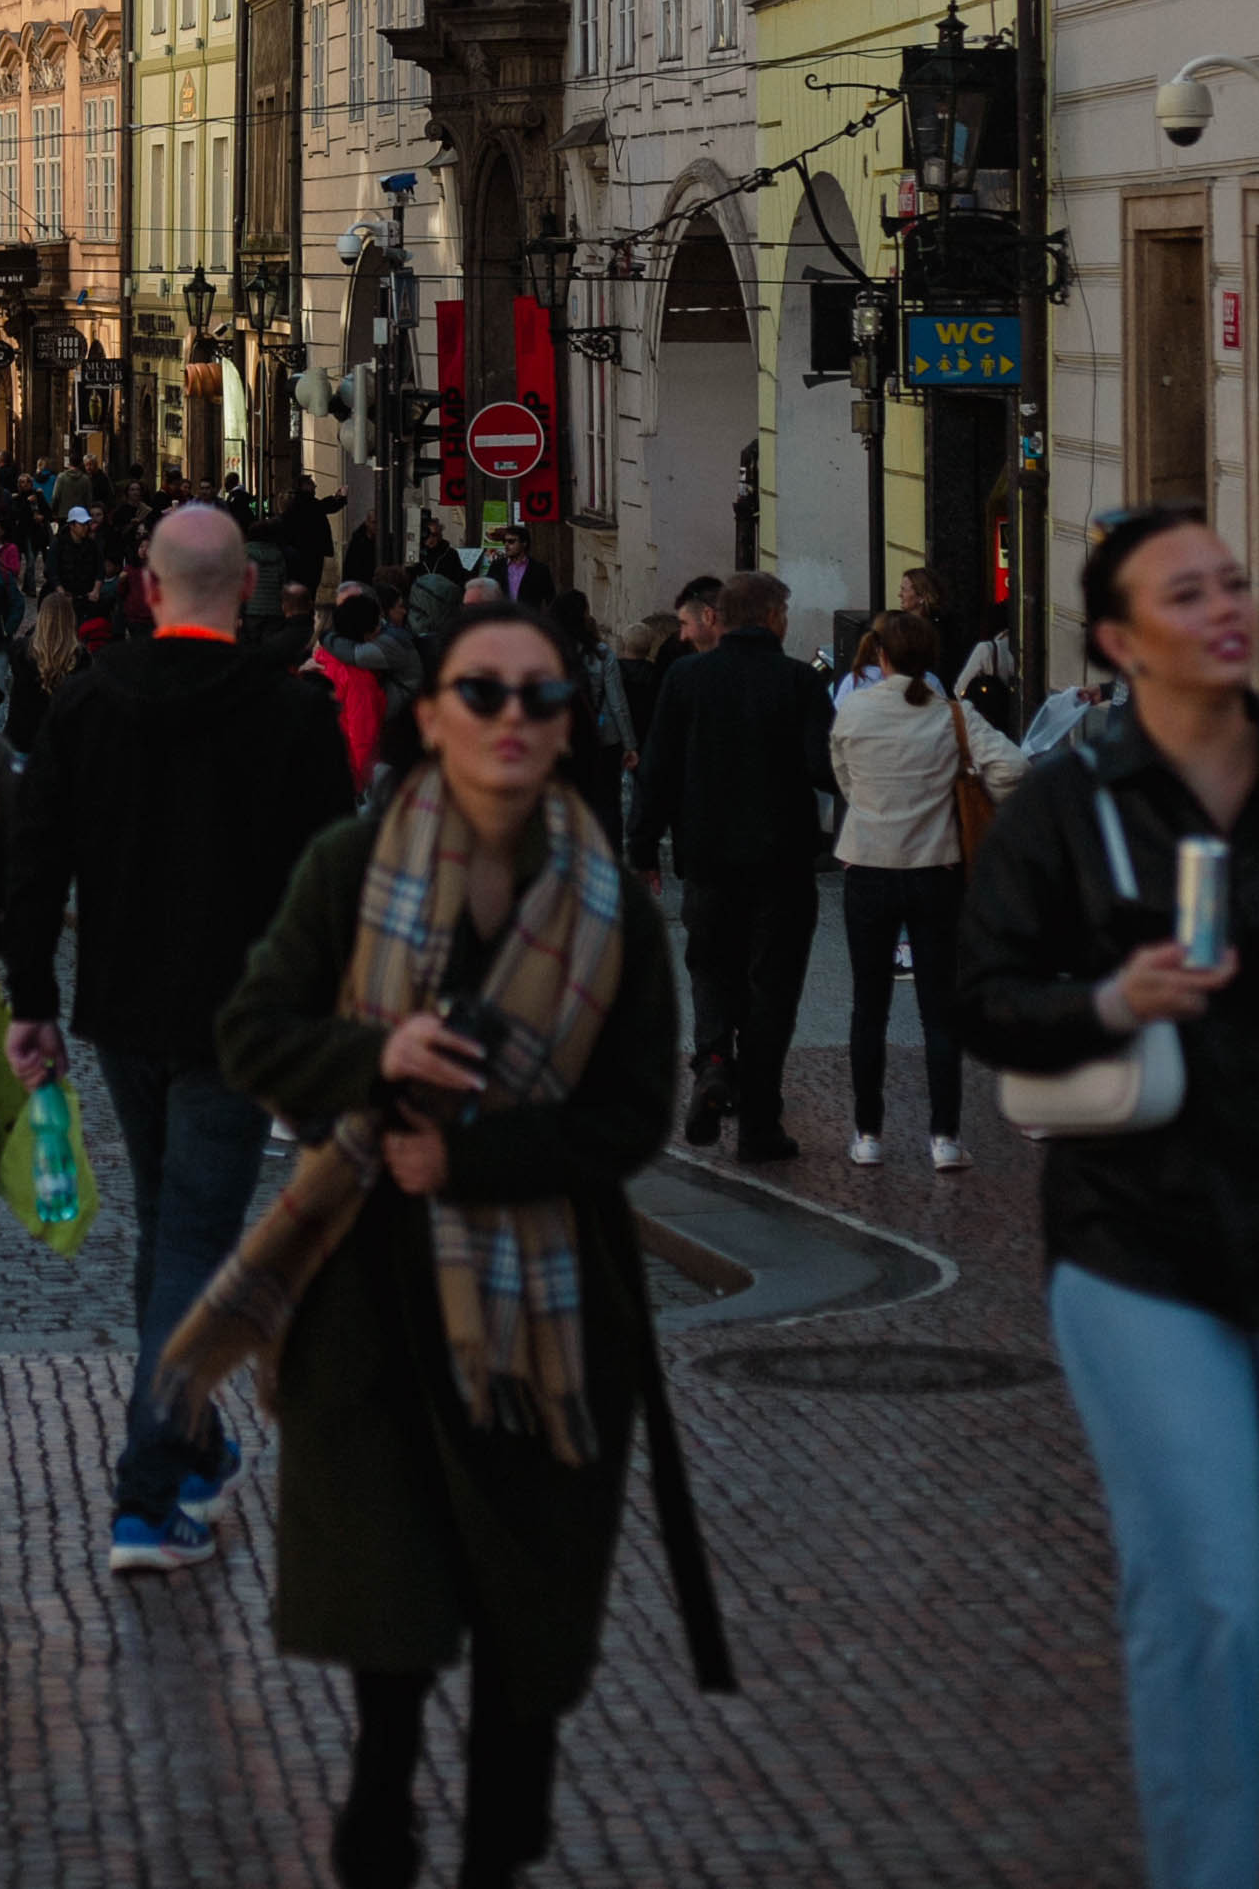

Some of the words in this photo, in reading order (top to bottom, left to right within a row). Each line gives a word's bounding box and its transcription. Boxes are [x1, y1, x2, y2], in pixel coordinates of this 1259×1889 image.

[935, 321, 996, 345] WC
[57, 336, 79, 348] GOOD
[57, 348, 79, 360] FOOD
[84, 361, 124, 371] MUSIC
[84, 371, 124, 383] CLUB
